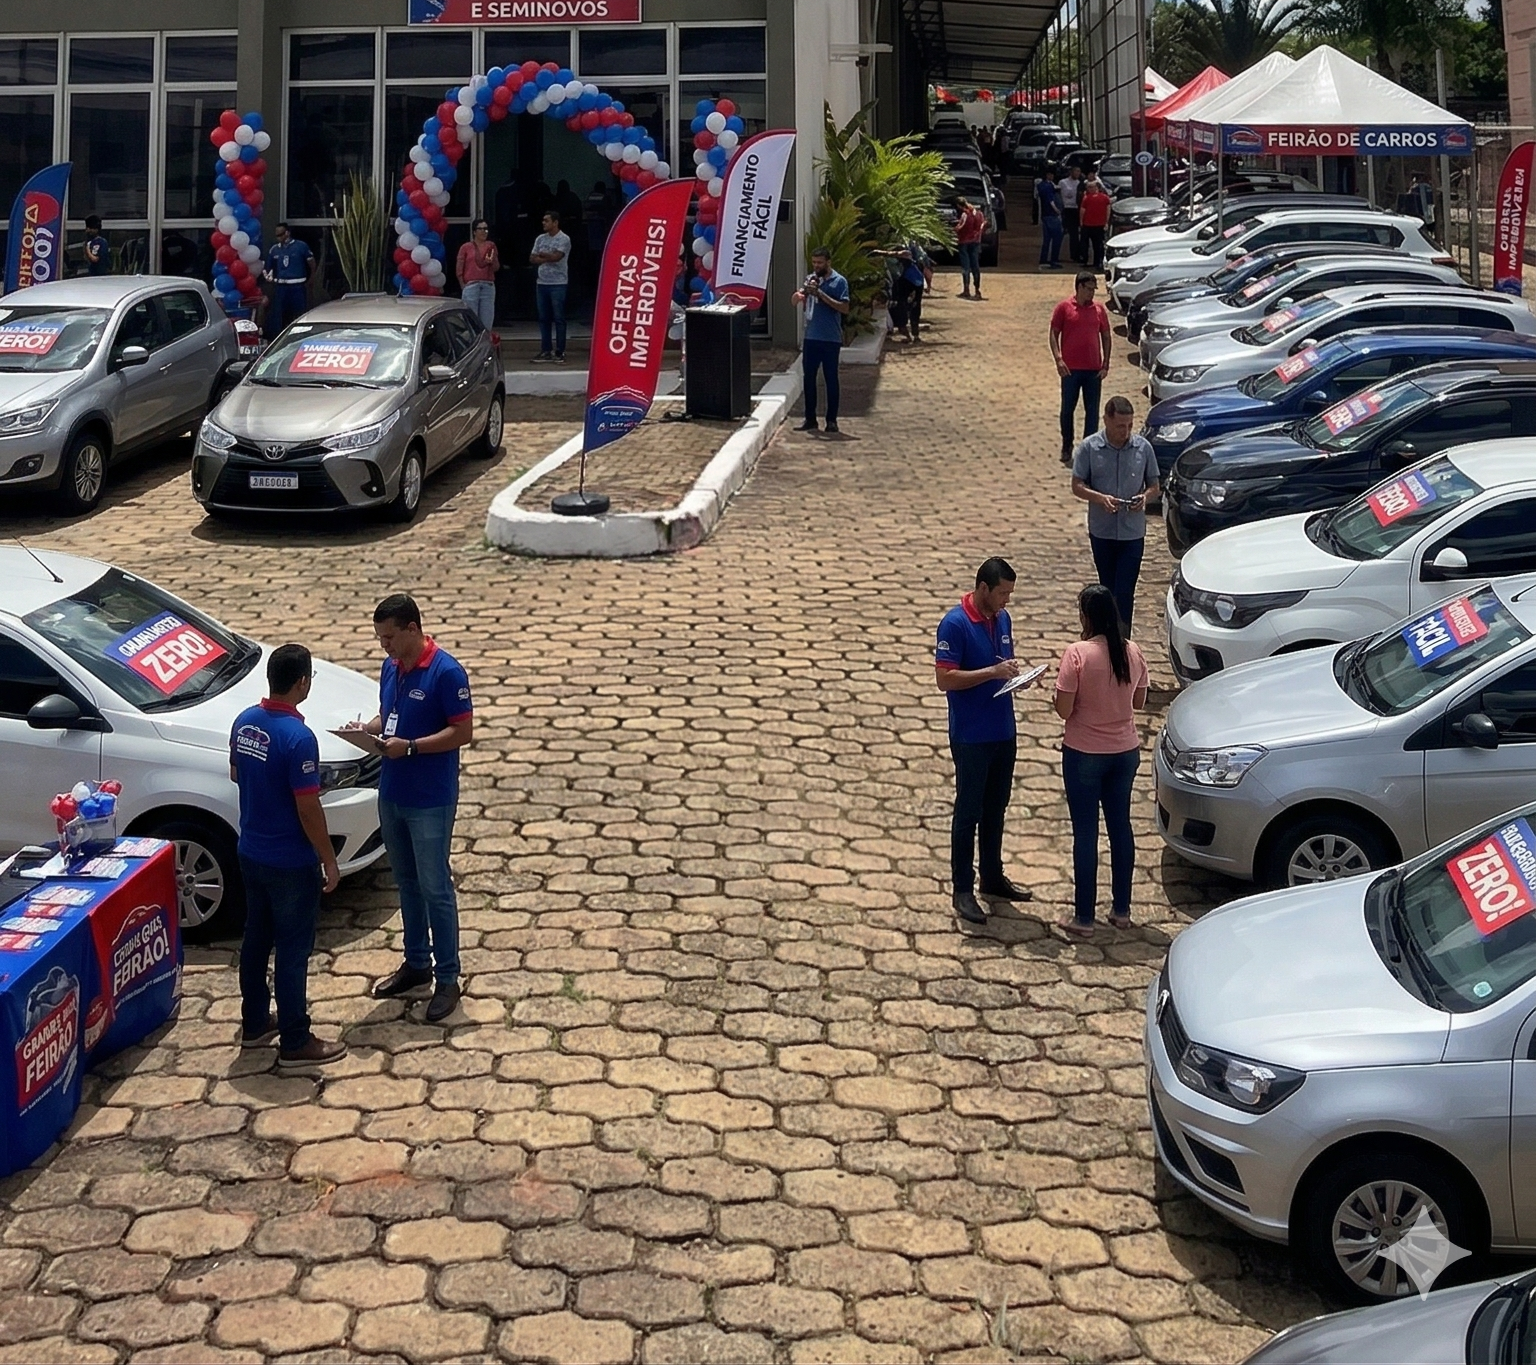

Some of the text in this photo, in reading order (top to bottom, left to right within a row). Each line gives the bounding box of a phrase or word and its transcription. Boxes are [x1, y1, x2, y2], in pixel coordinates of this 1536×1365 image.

[471, 0, 609, 18] E SEMINOVOS
[1268, 129, 1438, 147] FEIRÃO DE CARROS
[730, 153, 760, 278] FINANCIAMENTO
[609, 254, 639, 355] OFERTAS
[629, 217, 668, 369] IMPERDÍVEIS!
[0, 334, 52, 350] ERO!
[139, 630, 214, 684] ZERO!
[1457, 842, 1526, 923] ZERO!
